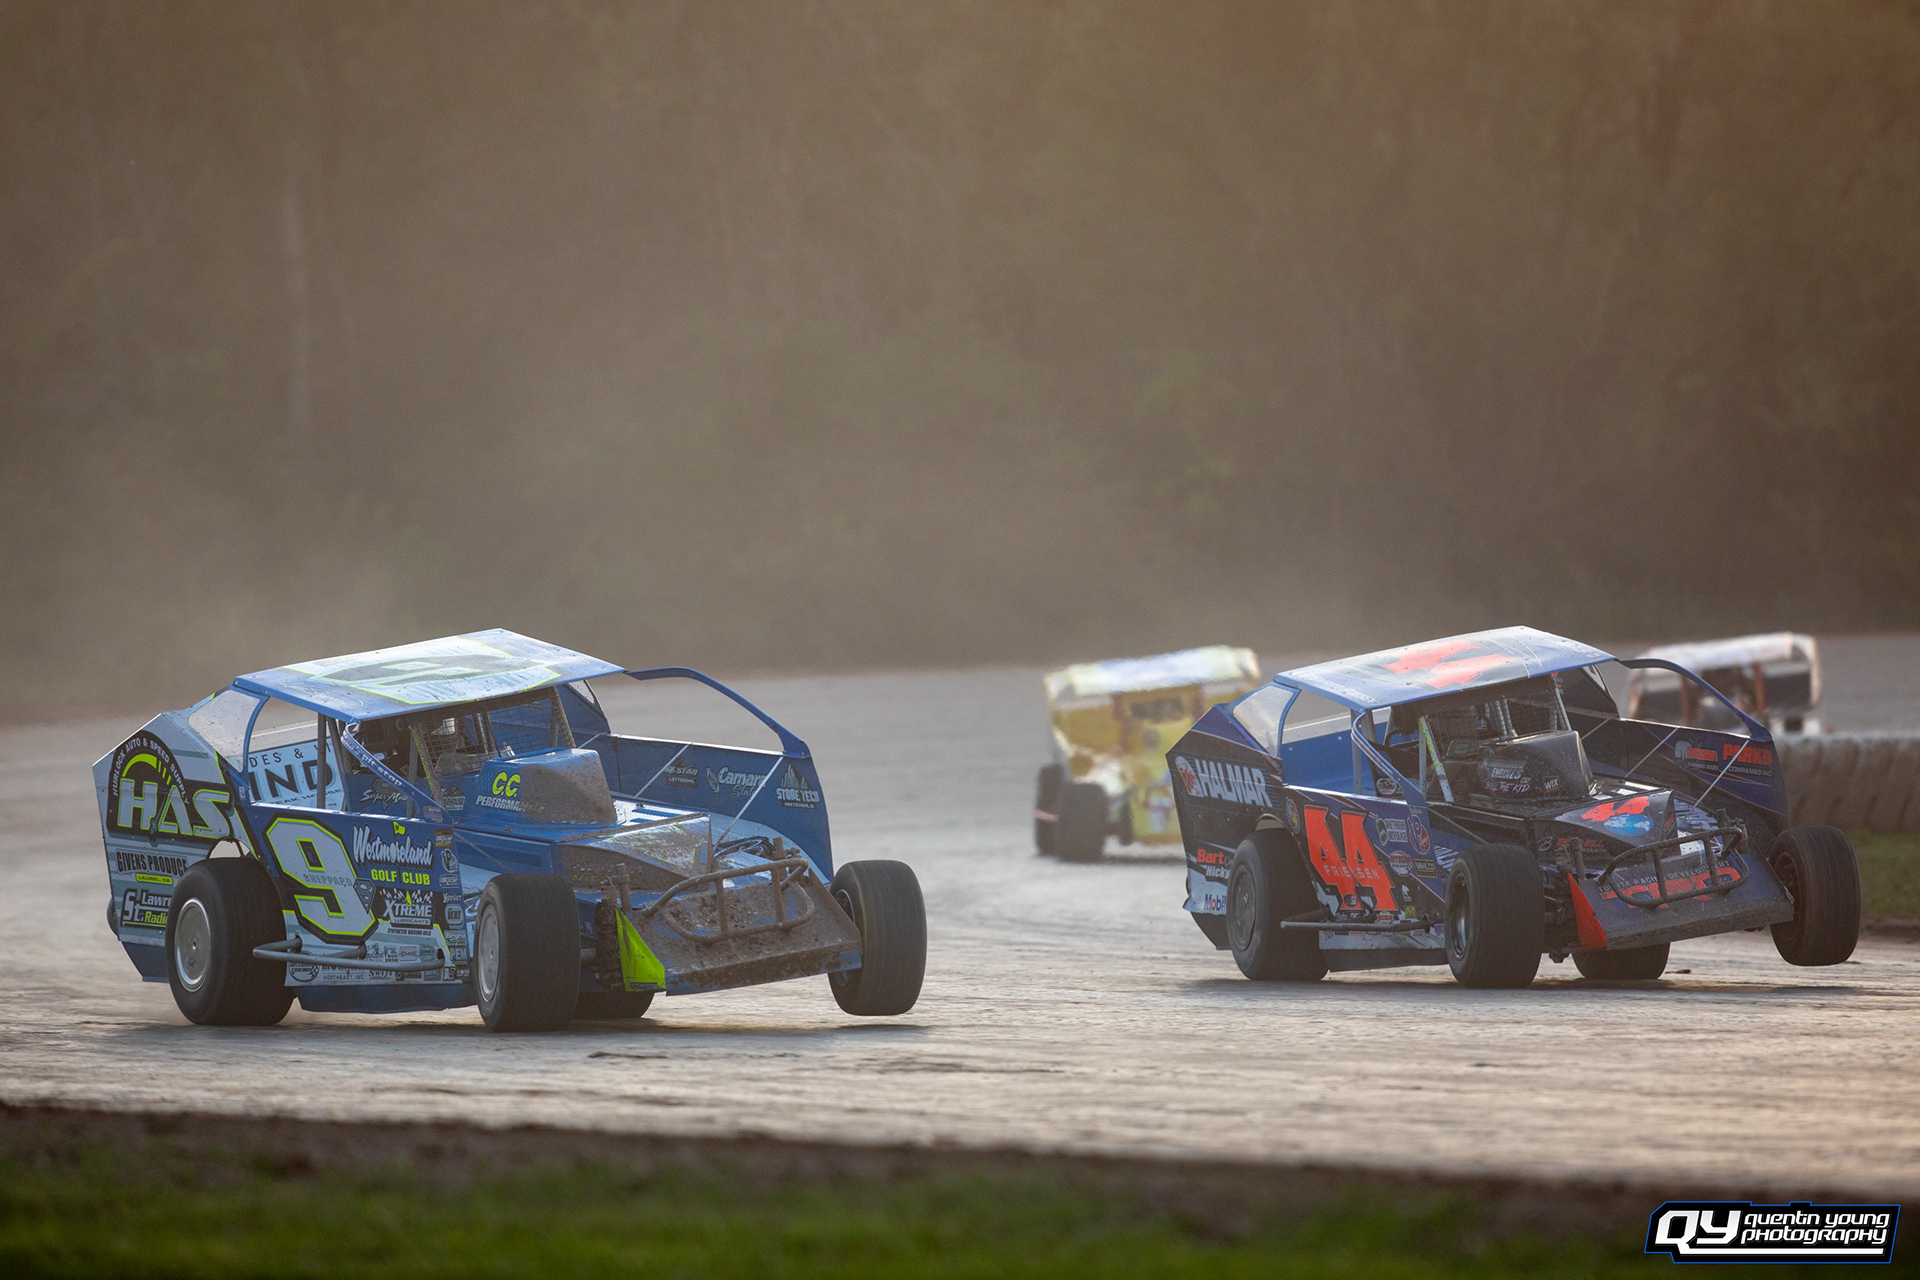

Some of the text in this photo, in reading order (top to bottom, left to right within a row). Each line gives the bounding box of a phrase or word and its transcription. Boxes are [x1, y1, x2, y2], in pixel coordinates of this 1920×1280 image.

[113, 738, 190, 805] HURLOCK AUTO & SPEED SUPPLY
[1194, 758, 1273, 808] HALMAR
[1512, 784, 1531, 793] KID
[1544, 778, 1559, 790] WIX
[118, 778, 230, 839] HAS
[353, 825, 433, 867] Westmoreland
[116, 851, 147, 873] GIVENS
[1197, 849, 1225, 865] Bart
[1304, 804, 1398, 910] 44
[265, 817, 376, 937] 9
[371, 869, 431, 886] GOLF CLUB
[1205, 865, 1231, 879] Nicky
[1324, 865, 1380, 880] FRIESEN
[382, 899, 433, 918] XTREME
[1204, 894, 1227, 912] Mobil
